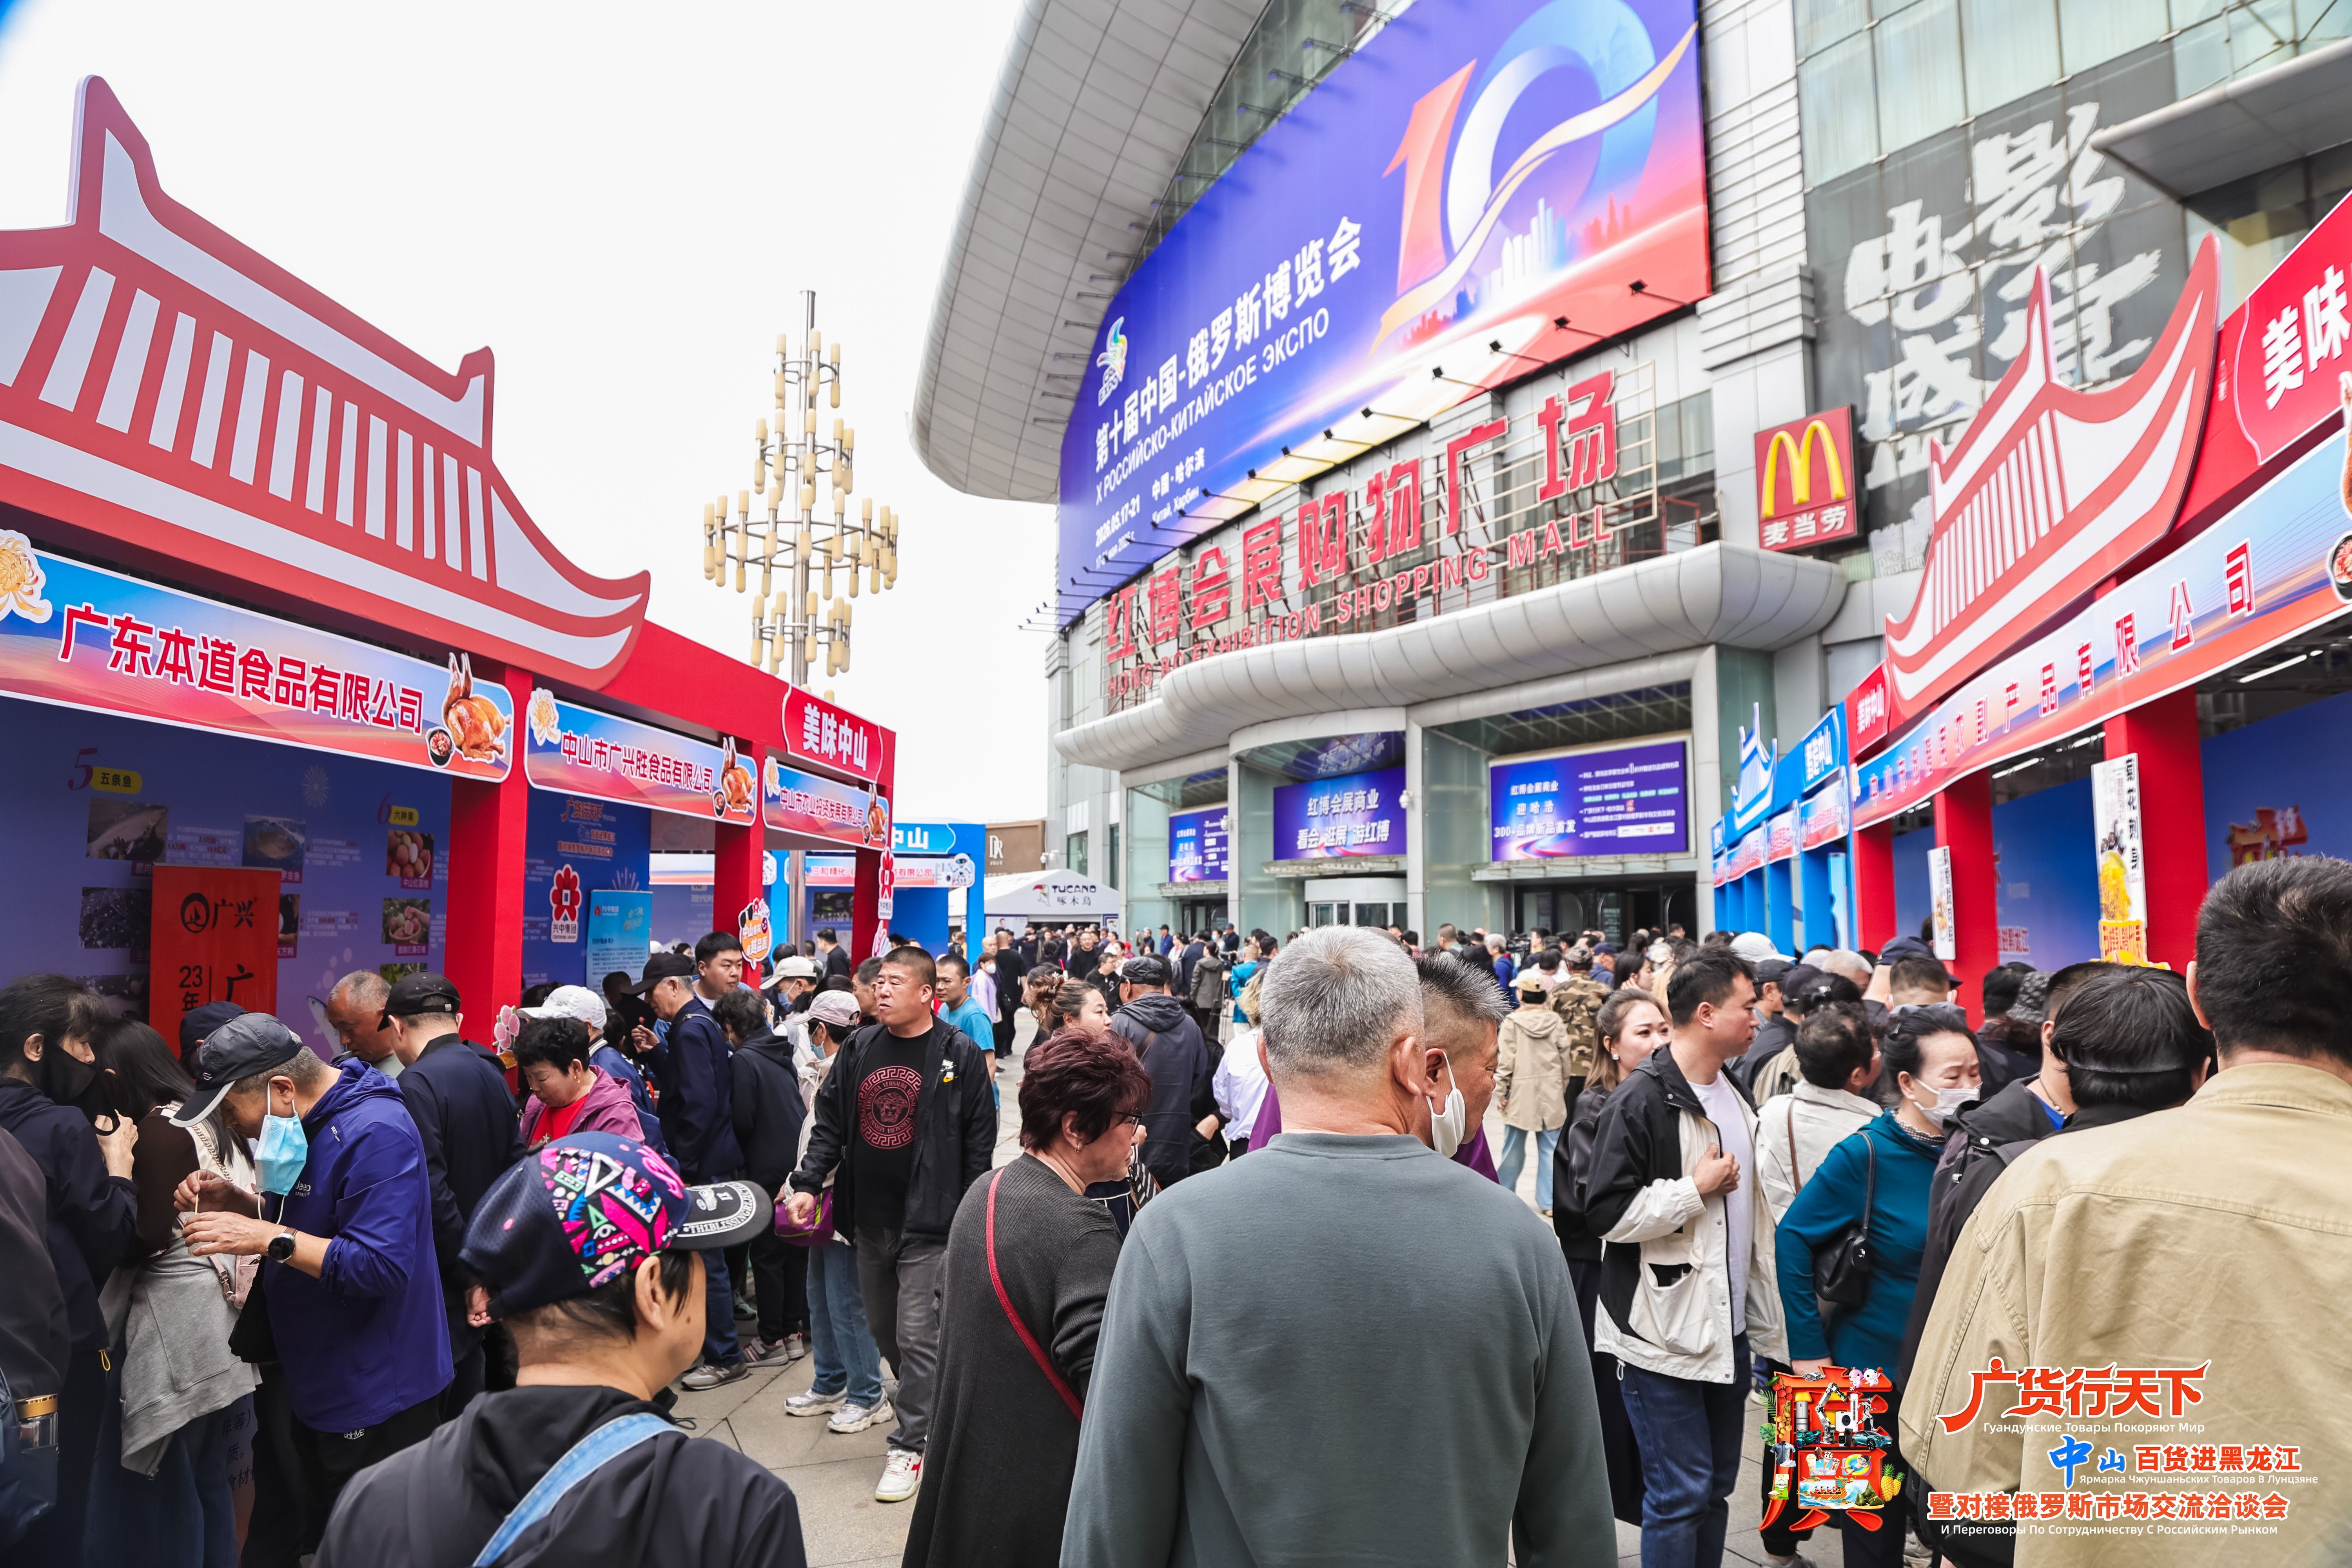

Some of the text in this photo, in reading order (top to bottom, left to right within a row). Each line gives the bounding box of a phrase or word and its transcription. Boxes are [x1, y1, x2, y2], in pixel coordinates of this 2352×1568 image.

[1096, 216, 1361, 474] 第十届中国-俄罗斯博览会
[2262, 263, 2352, 412] 美味
[1104, 354, 1257, 498] РОССИЙСКО-КИТАЙСКОЕ
[1262, 307, 1329, 373] ЭКСПО
[1152, 446, 1205, 501] 中国·哈尔滨
[1106, 367, 1617, 662] 红博会展购物广场
[1762, 504, 1847, 548] 麦当劳
[1108, 505, 1615, 698] HONG BO EXHIBITION SHOPPING MALL
[58, 602, 424, 736] 广东本道食品有限公司
[802, 703, 868, 772] 美味中山
[67, 747, 98, 790] 5
[100, 772, 132, 788] 五条鱼
[561, 730, 713, 795] 中山市广兴胜食品有限公司
[1307, 788, 1379, 818] 红博会展商业
[1510, 780, 1559, 796] 红博会展商业
[780, 786, 864, 828] 中山市农业投资发展有限公司
[1297, 820, 1390, 850] 看会 逛展 游红博
[1493, 819, 1576, 838] 300+品牌新品首发
[989, 835, 1004, 859] DR
[1052, 884, 1096, 893] TUCANO
[211, 898, 254, 929] 广兴
[552, 924, 576, 934] 兴中集团
[179, 965, 203, 988] 23
[181, 991, 199, 1012] 年
[295, 1180, 311, 1192] Jeep
